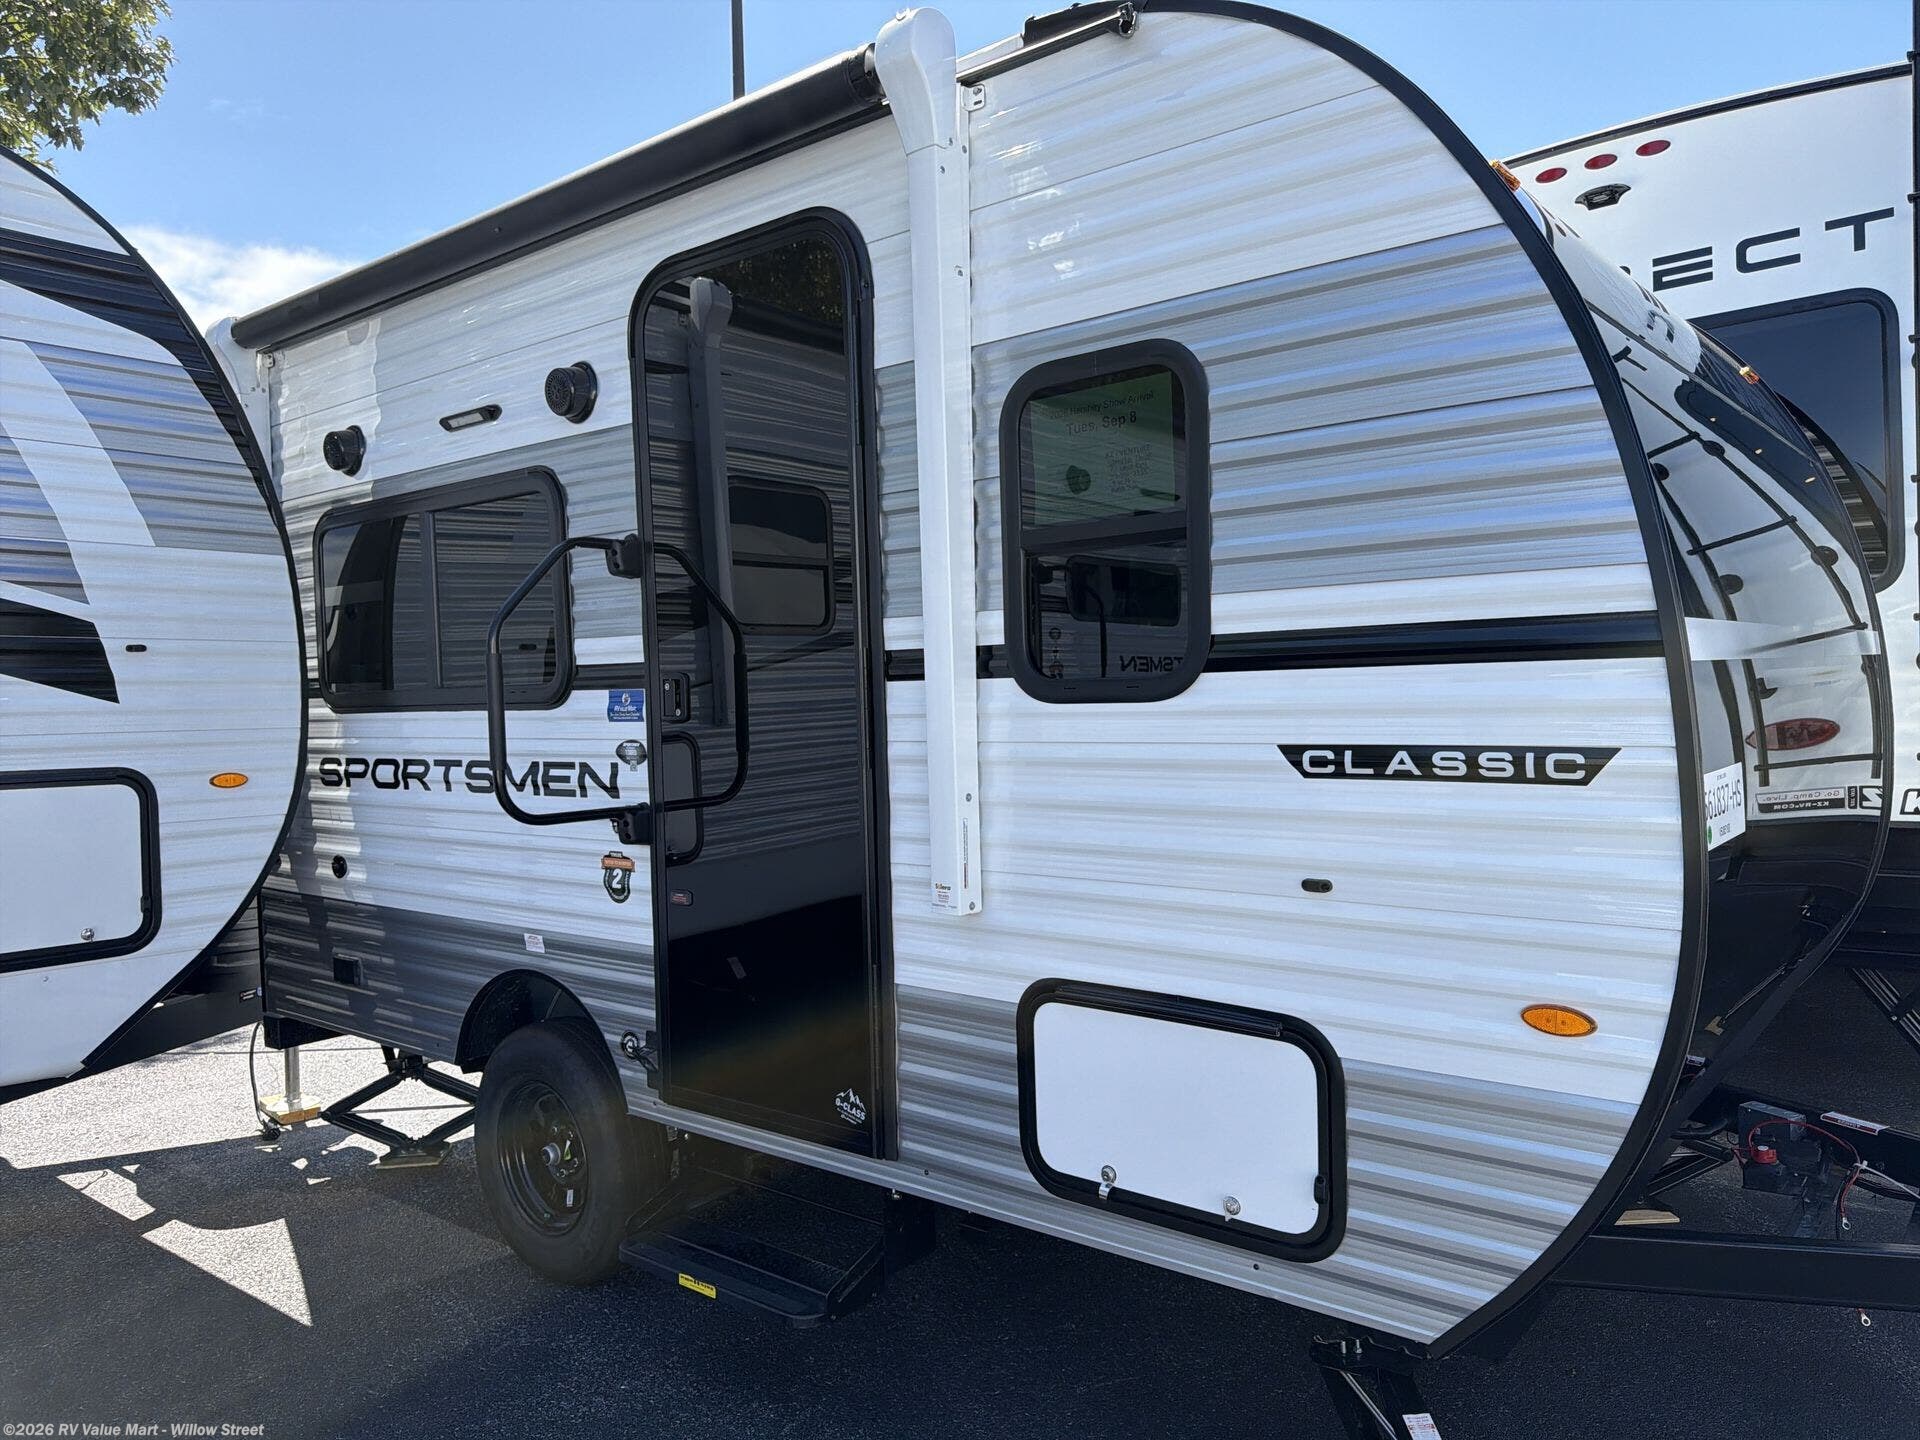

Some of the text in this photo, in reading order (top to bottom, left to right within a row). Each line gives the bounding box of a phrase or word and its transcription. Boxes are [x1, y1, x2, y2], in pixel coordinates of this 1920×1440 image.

[1620, 207, 1894, 292] ECT
[1102, 415, 1126, 429] Sep
[1129, 411, 1137, 424] 8
[319, 757, 620, 799] SPORTSMEN
[1302, 749, 1586, 780] CLASSIC
[611, 868, 623, 889] 2
